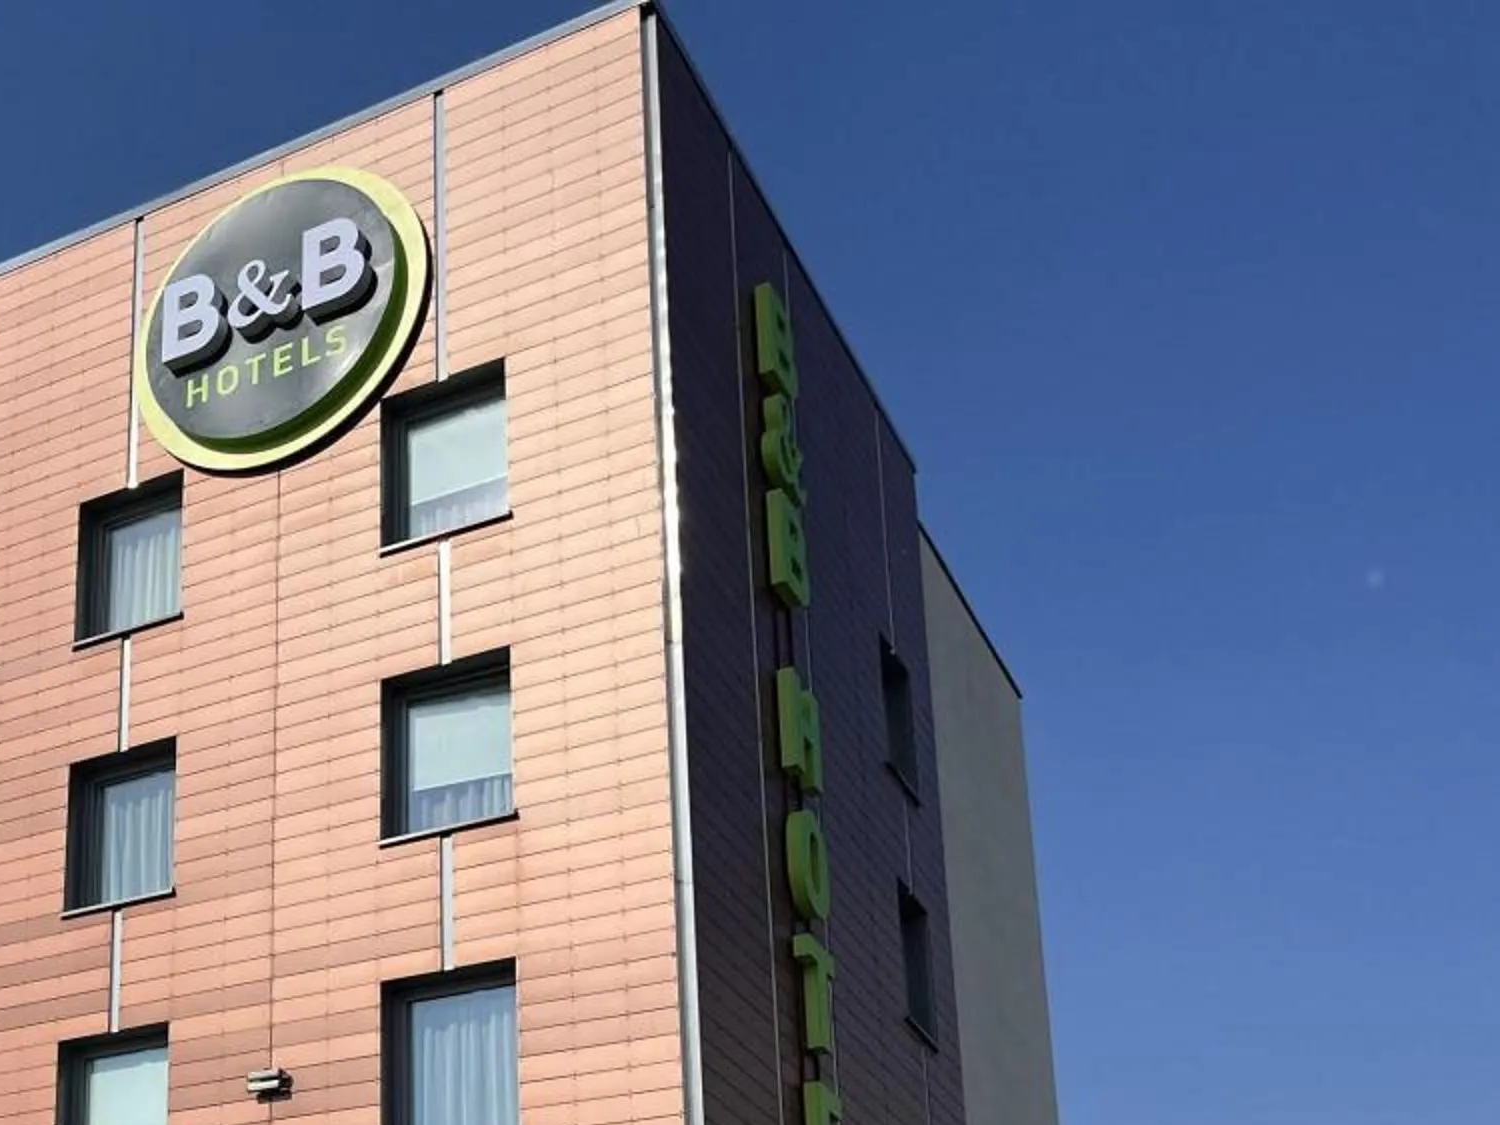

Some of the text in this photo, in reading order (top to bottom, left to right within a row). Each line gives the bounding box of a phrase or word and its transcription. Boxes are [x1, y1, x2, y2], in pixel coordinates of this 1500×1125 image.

[161, 217, 374, 372] B&B
[185, 325, 348, 408] HOTELS
[755, 282, 810, 607] B&B
